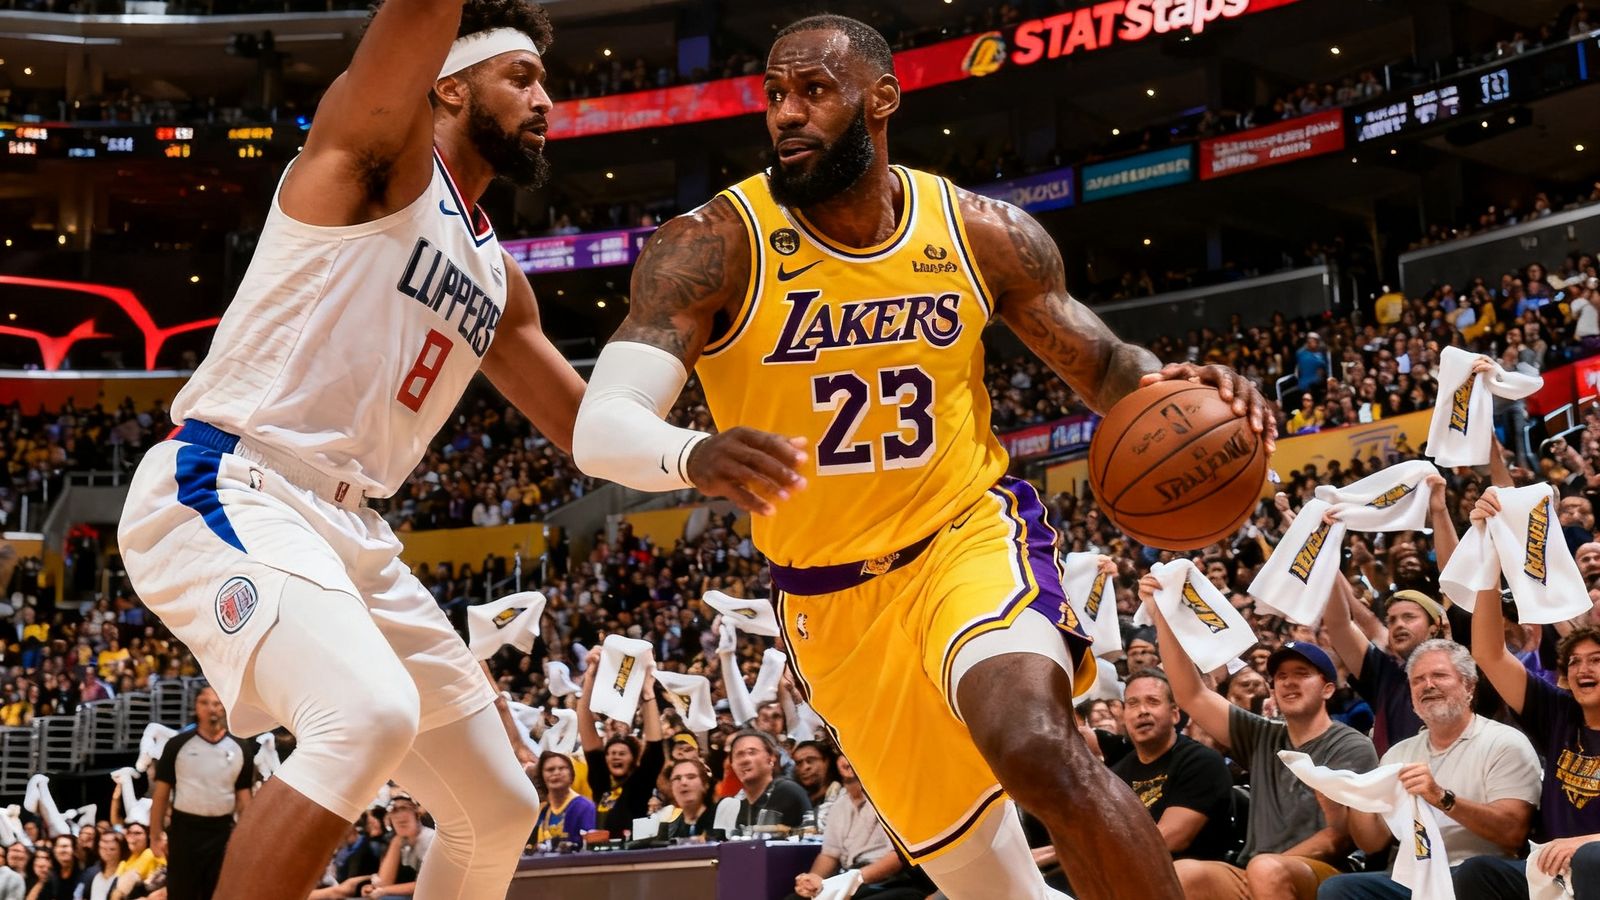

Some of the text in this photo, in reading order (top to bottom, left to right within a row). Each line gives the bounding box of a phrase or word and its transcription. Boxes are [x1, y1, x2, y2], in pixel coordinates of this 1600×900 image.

[397, 237, 502, 358] CLIPPERS
[397, 329, 454, 413] 8
[811, 364, 937, 477] 23
